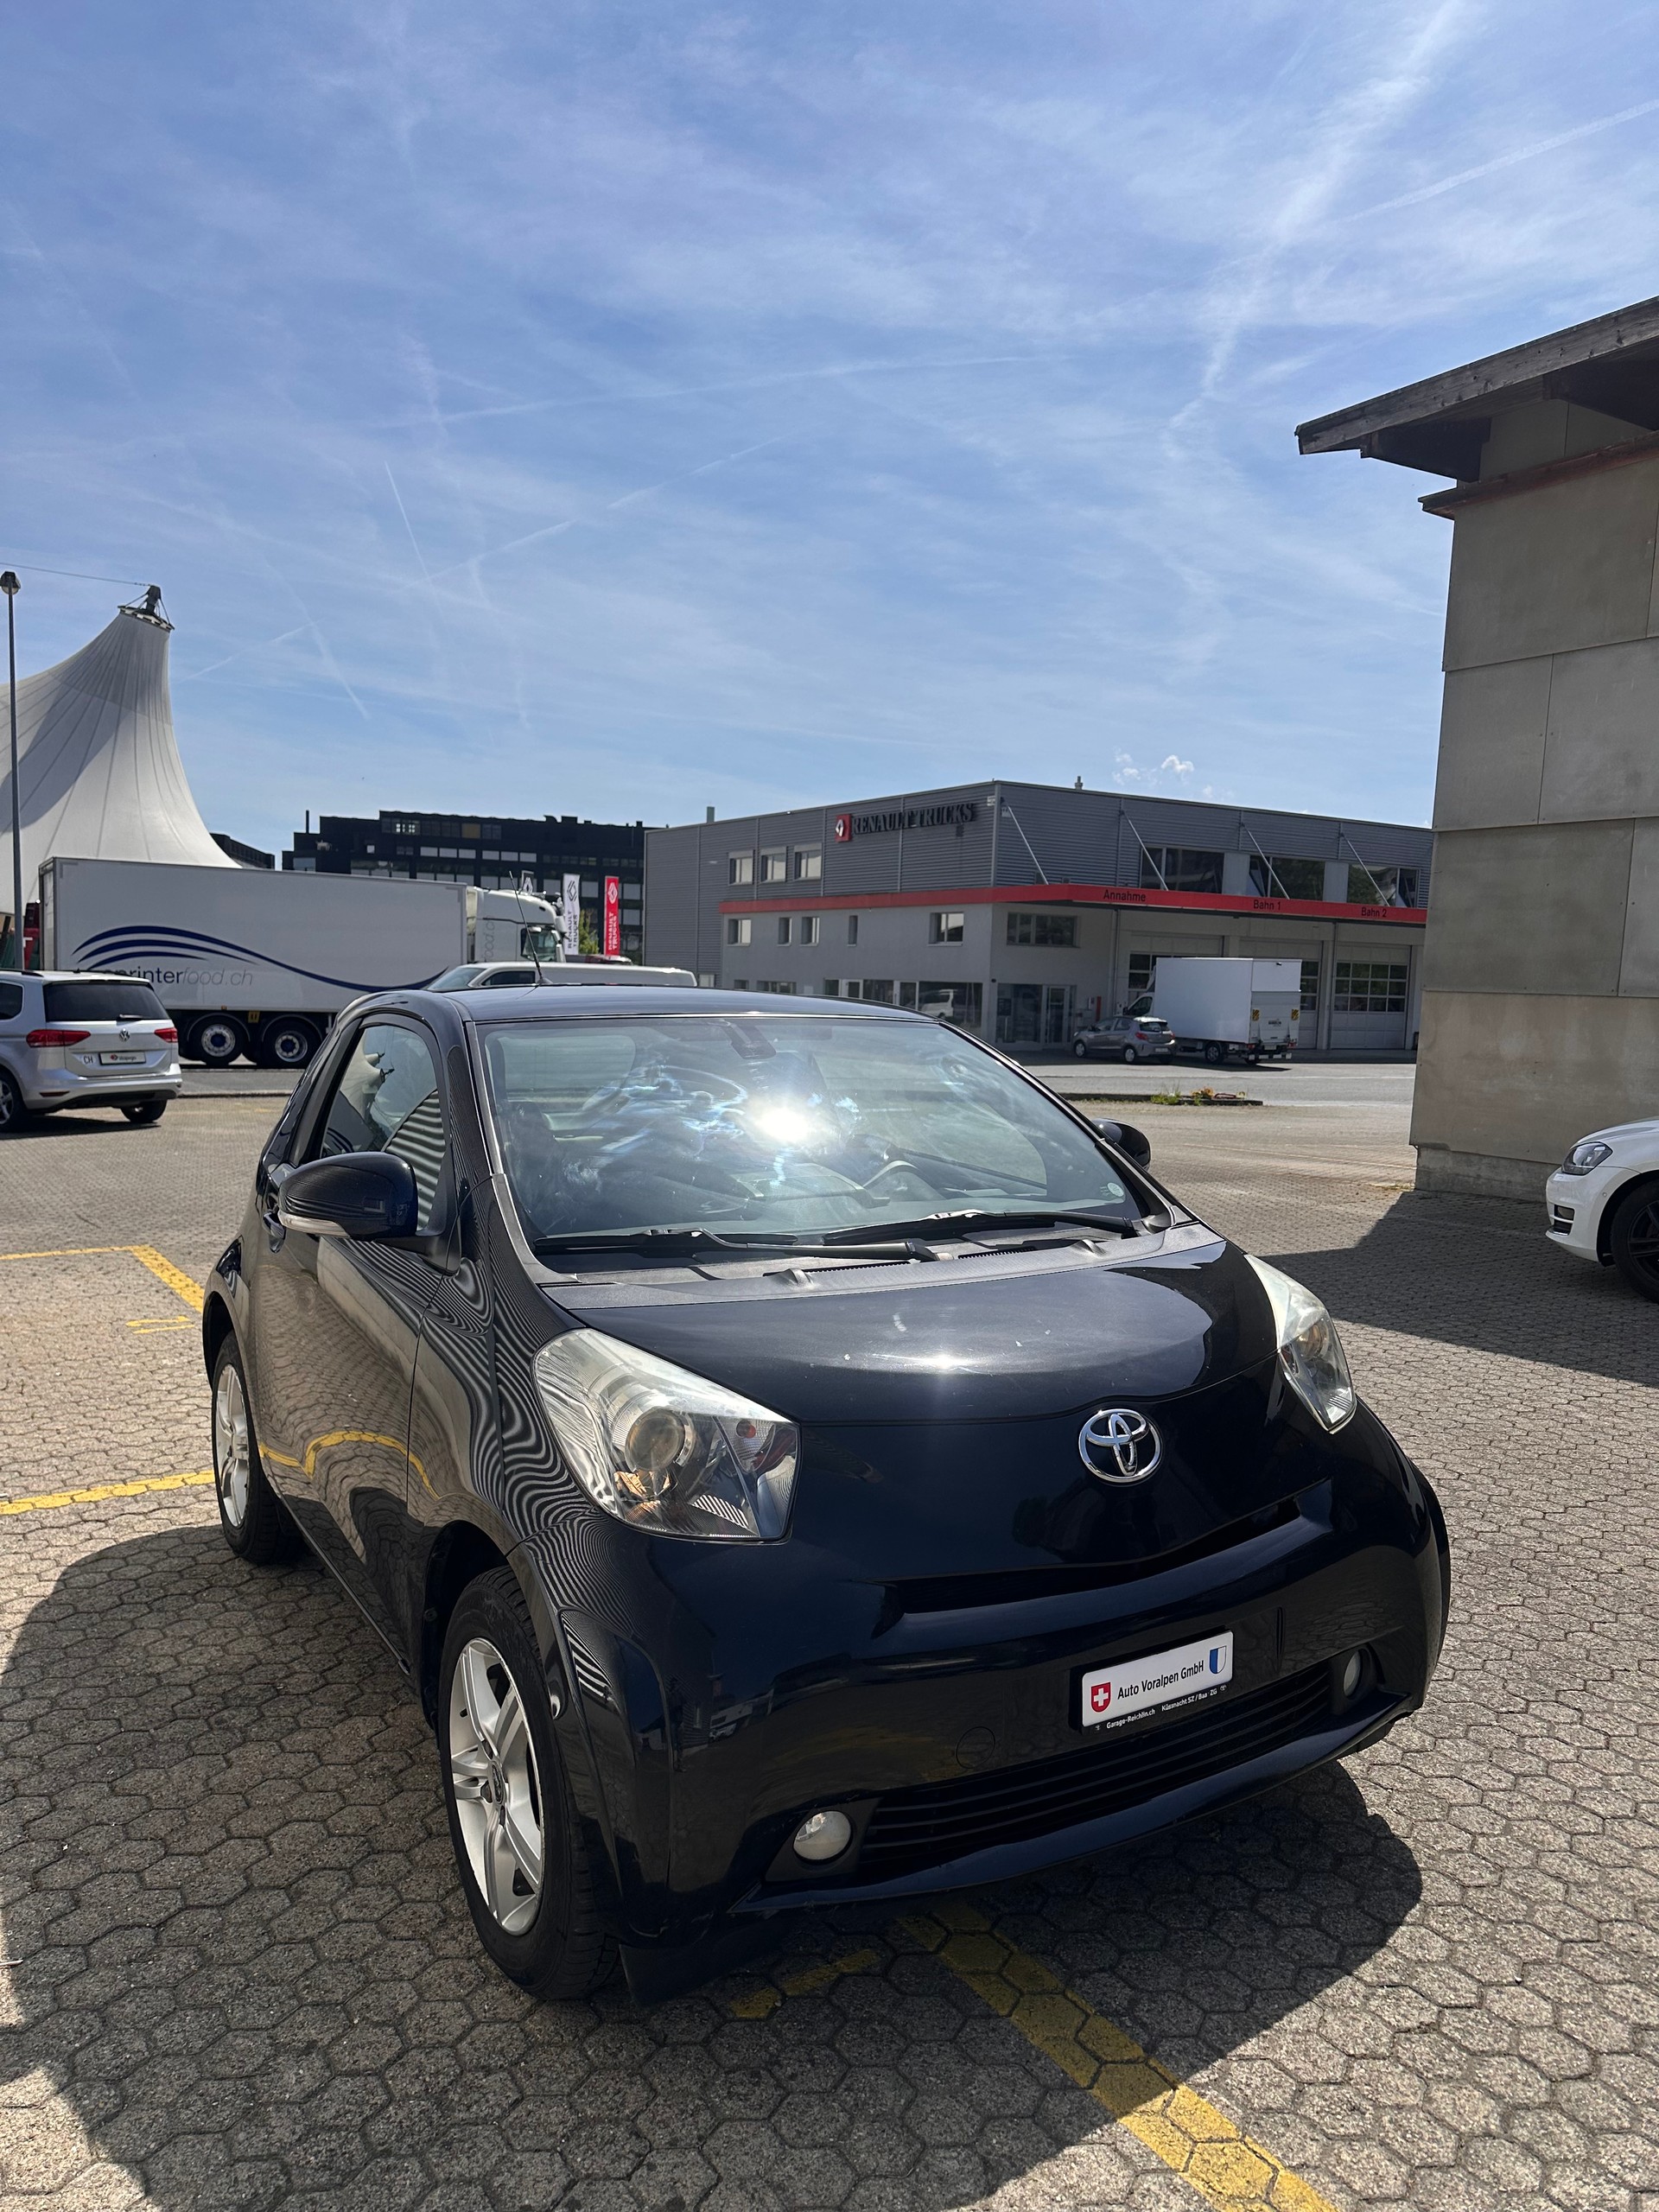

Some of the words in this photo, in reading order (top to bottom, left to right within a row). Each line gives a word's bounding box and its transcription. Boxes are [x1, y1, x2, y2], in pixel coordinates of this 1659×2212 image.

[852, 810, 912, 836] RENAULT
[913, 803, 975, 828] TRUCKS
[1103, 889, 1147, 902] Annahme
[1253, 899, 1274, 911] Bahn
[1277, 901, 1281, 911] 1
[1361, 906, 1380, 918] Bahn
[1382, 909, 1387, 918] 2
[105, 966, 253, 986] rinterfood.ch
[83, 1055, 94, 1064] CH
[1117, 1683, 1139, 1700] Auto
[1141, 1671, 1179, 1692] Voralpen
[1180, 1660, 1205, 1680] GmbH
